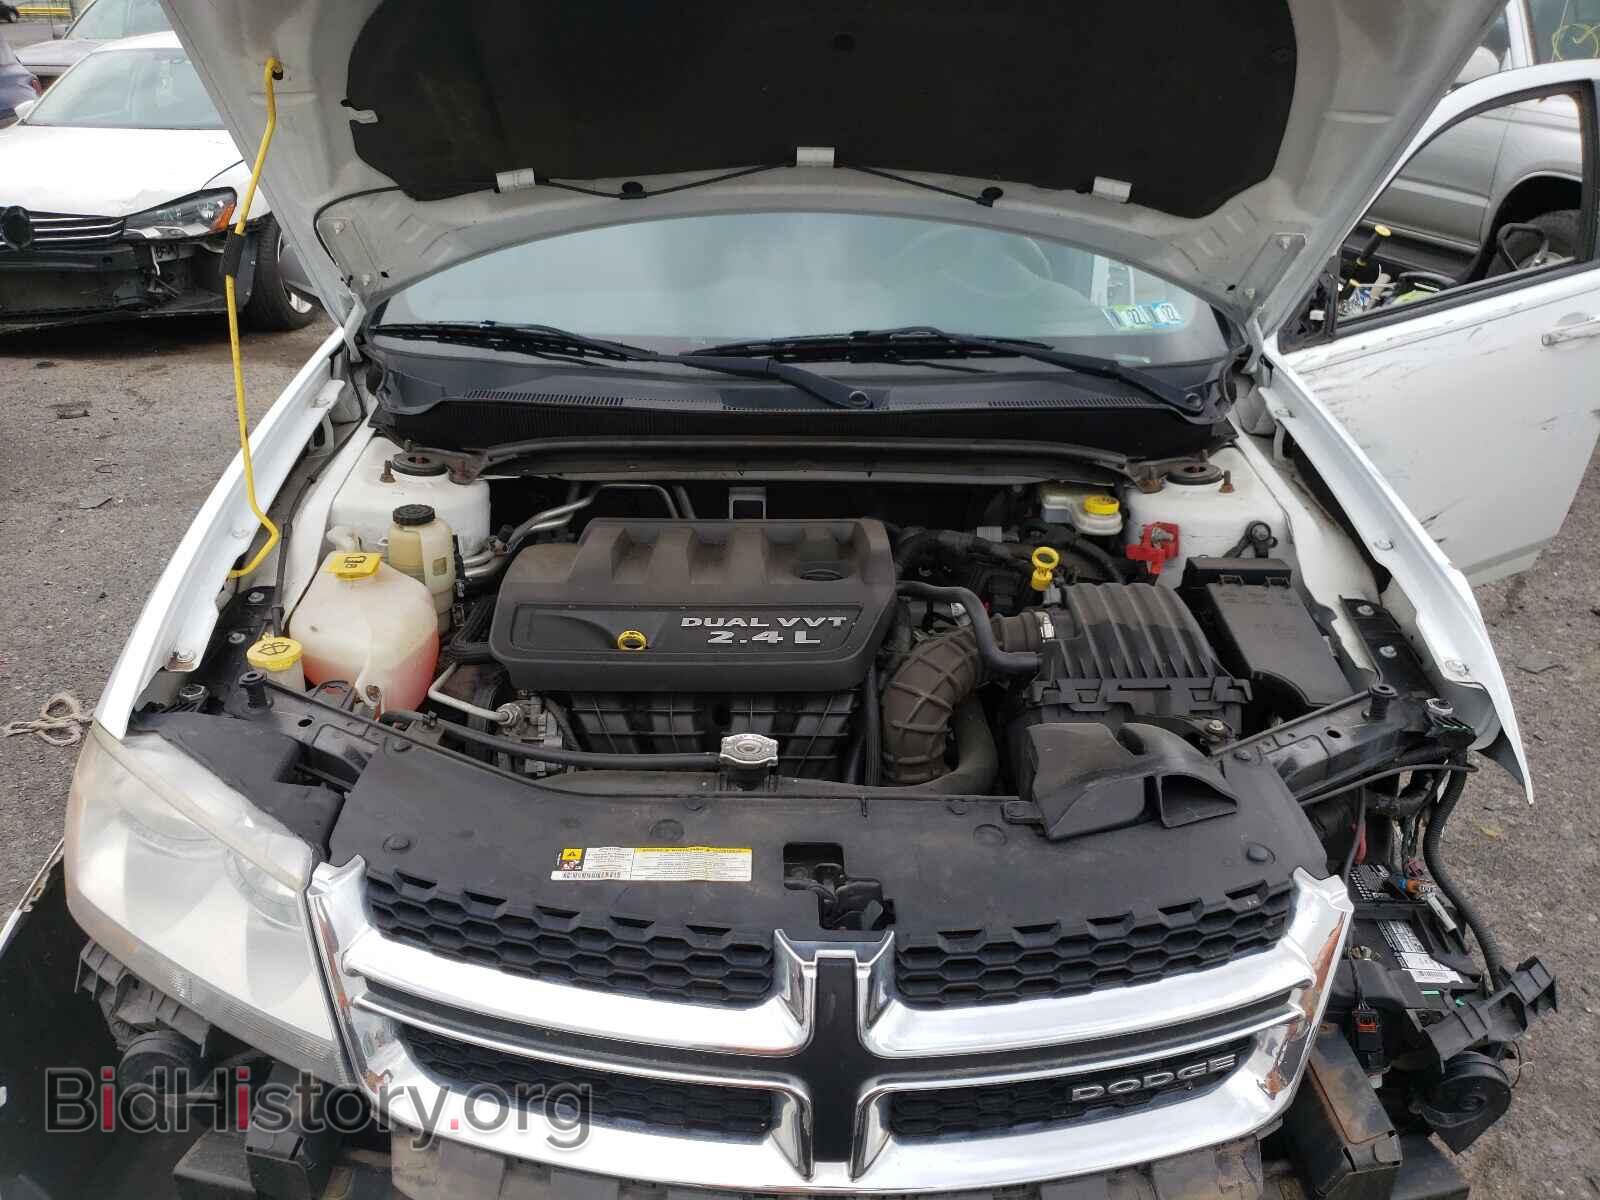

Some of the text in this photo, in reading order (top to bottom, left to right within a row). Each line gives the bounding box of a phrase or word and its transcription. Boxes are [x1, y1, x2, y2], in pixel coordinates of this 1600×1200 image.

[681, 616, 847, 627] DUAL VVT
[1071, 1054, 1237, 1101] DODGE
